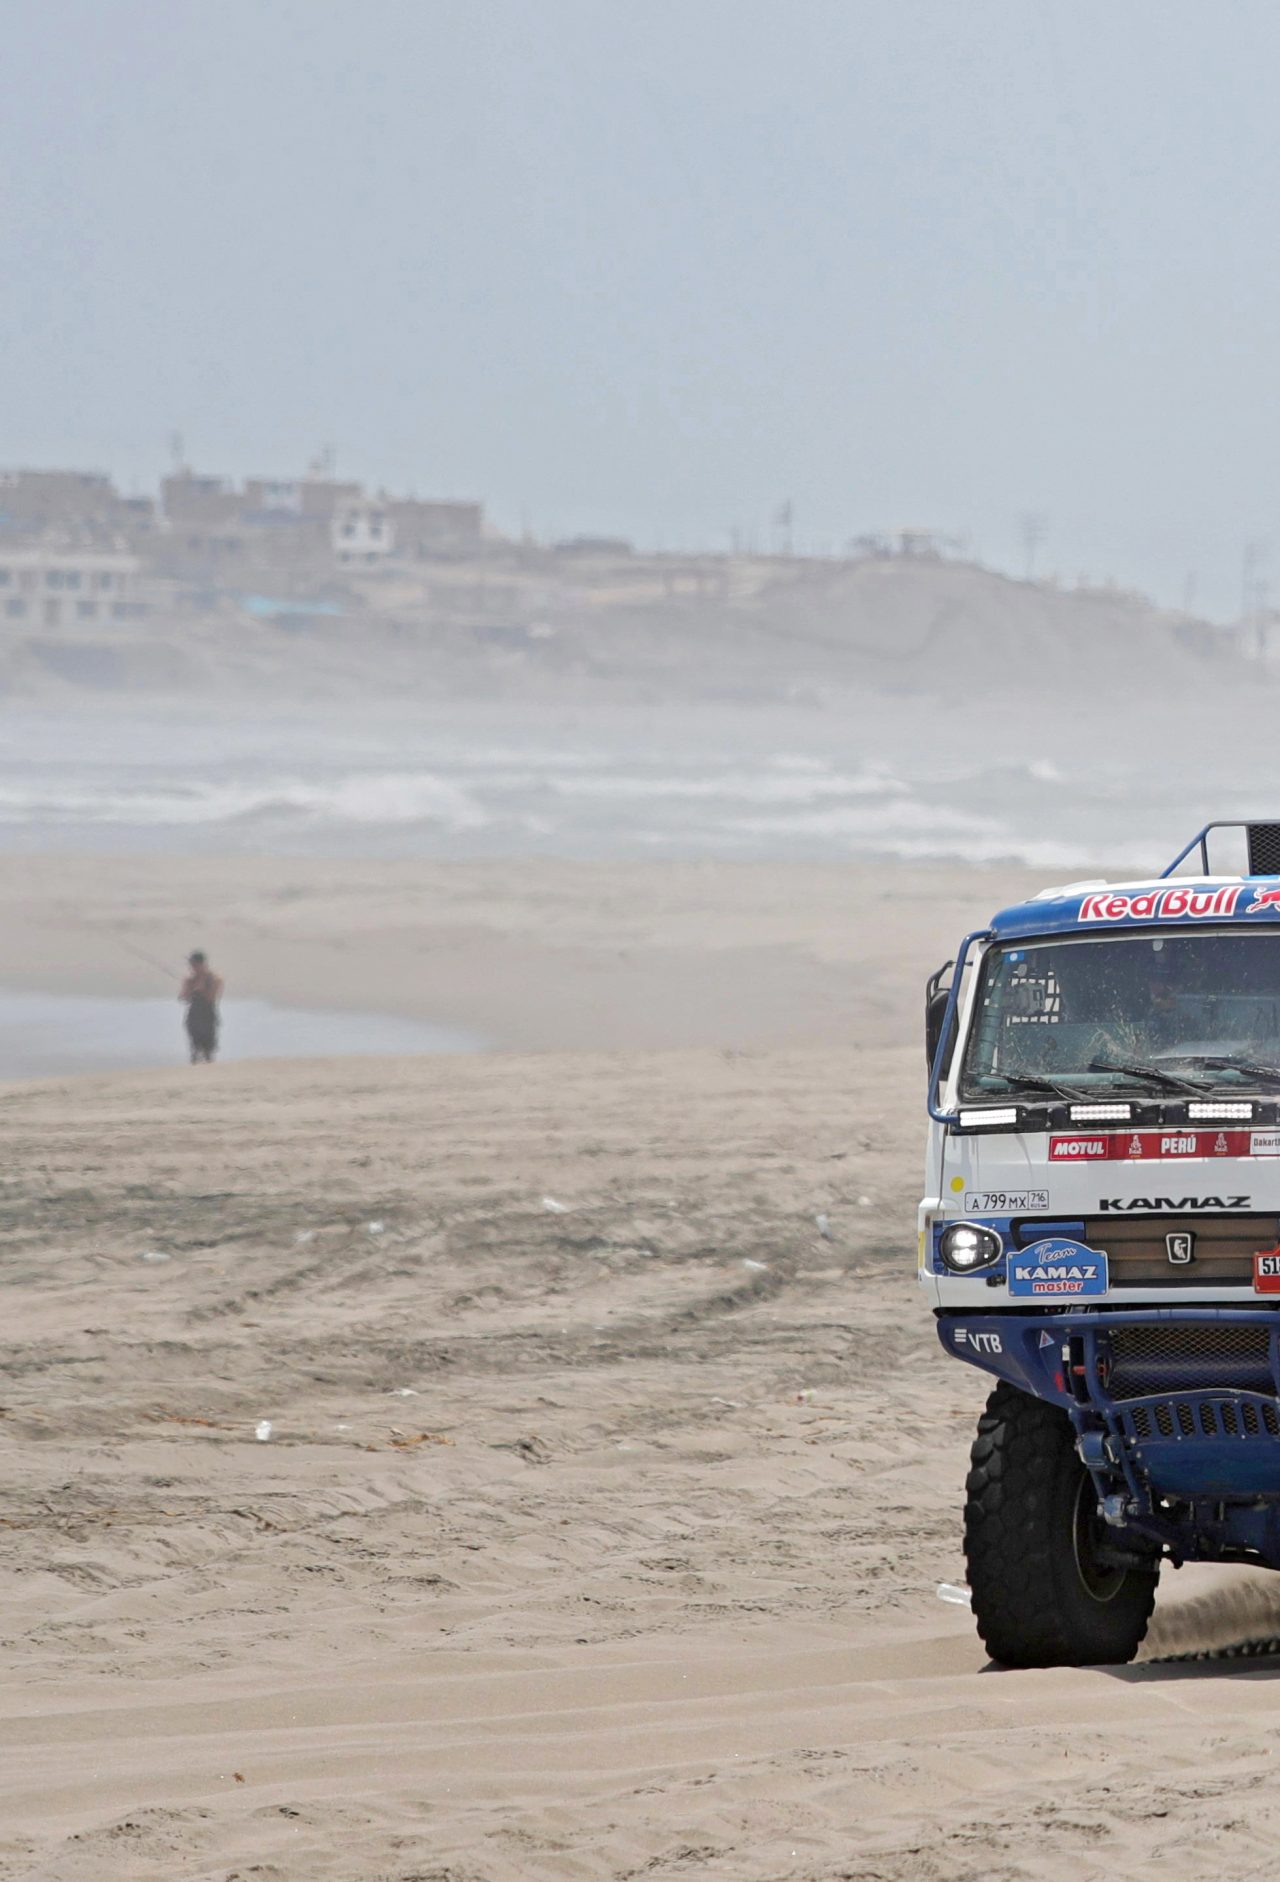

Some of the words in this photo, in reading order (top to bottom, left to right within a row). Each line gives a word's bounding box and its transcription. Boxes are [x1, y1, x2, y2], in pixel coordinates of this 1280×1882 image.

[1078, 888, 1161, 922] Red
[1158, 886, 1243, 919] Bull
[1053, 1141, 1105, 1156] MOTUL
[1161, 1134, 1197, 1155] PERÚ
[1099, 1195, 1252, 1211] KAMAZ
[1035, 1243, 1077, 1265] Team
[1015, 1265, 1097, 1281] KAMAZ
[1033, 1280, 1084, 1293] master
[968, 1333, 1003, 1354] VTB
